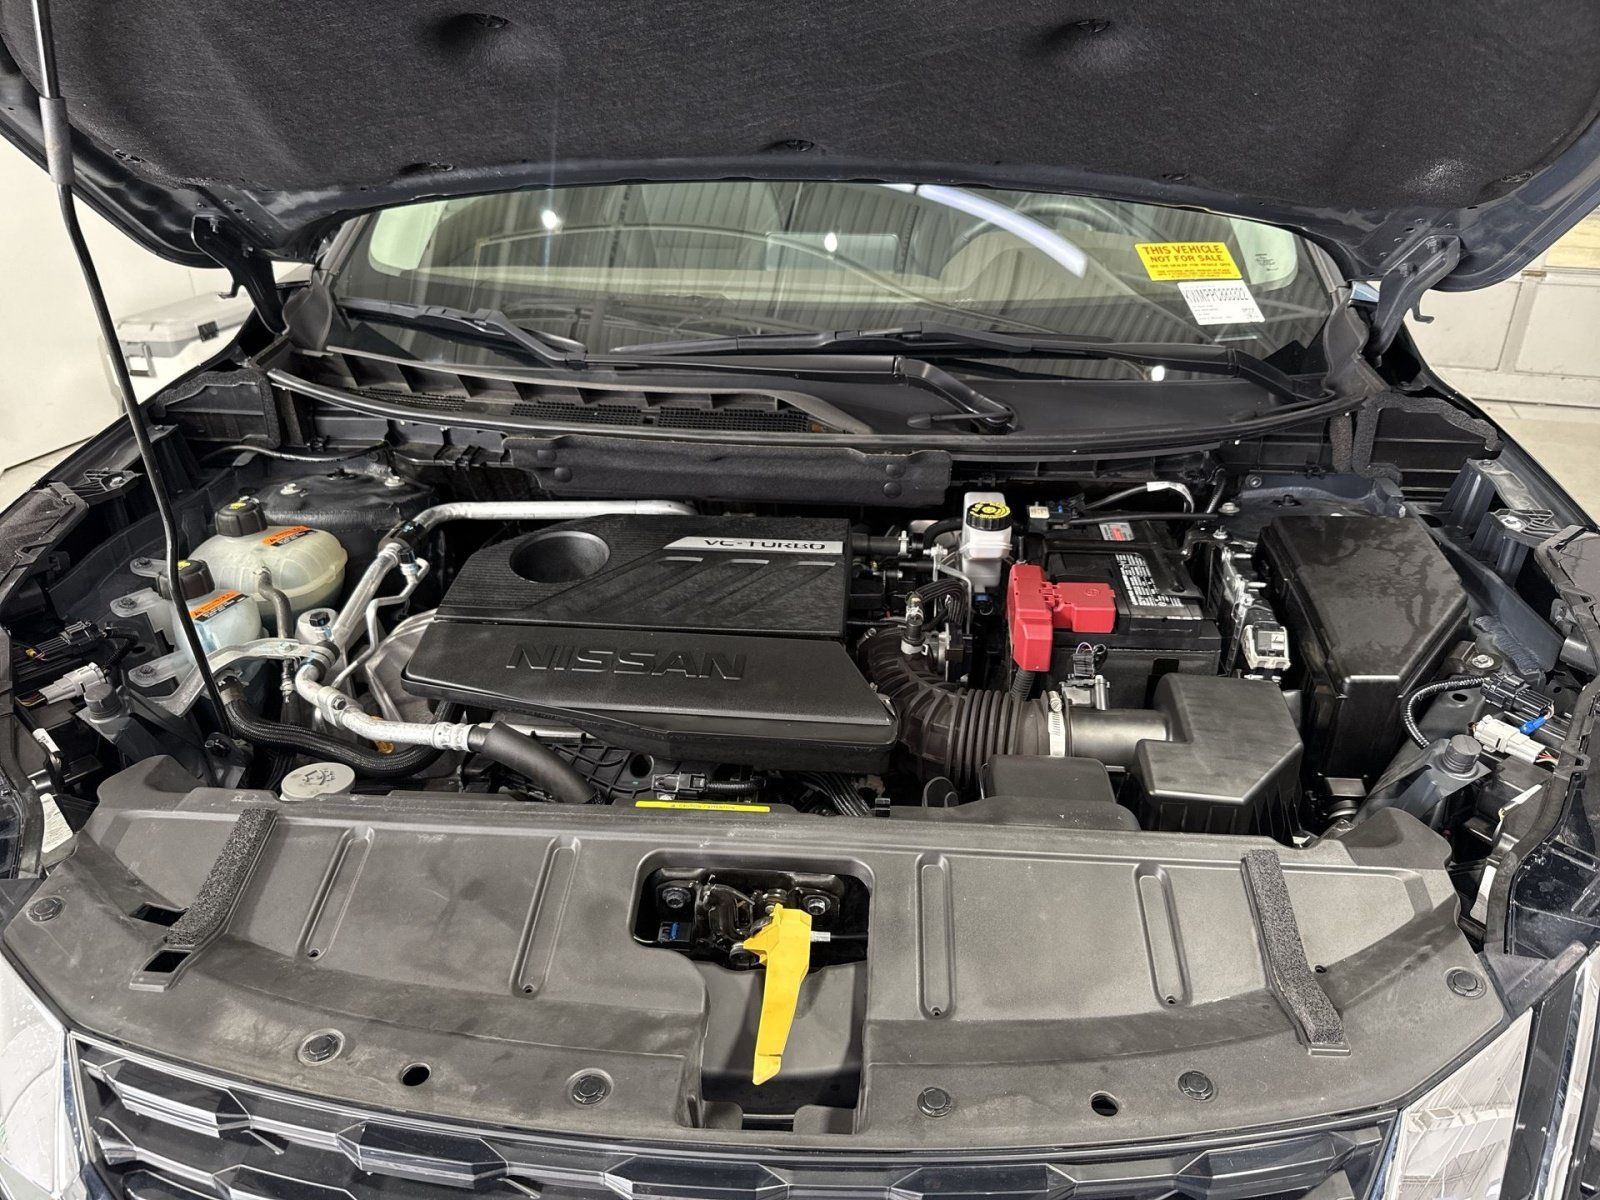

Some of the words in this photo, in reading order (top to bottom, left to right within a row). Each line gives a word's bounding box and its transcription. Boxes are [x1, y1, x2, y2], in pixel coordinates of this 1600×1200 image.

[1143, 246, 1171, 255] THIS
[1173, 245, 1223, 254] VEHICLE
[1150, 255, 1171, 263] NOT
[1198, 254, 1224, 262] SALE
[704, 539, 826, 550] VC-TURBO
[506, 643, 747, 680] NISSAN
